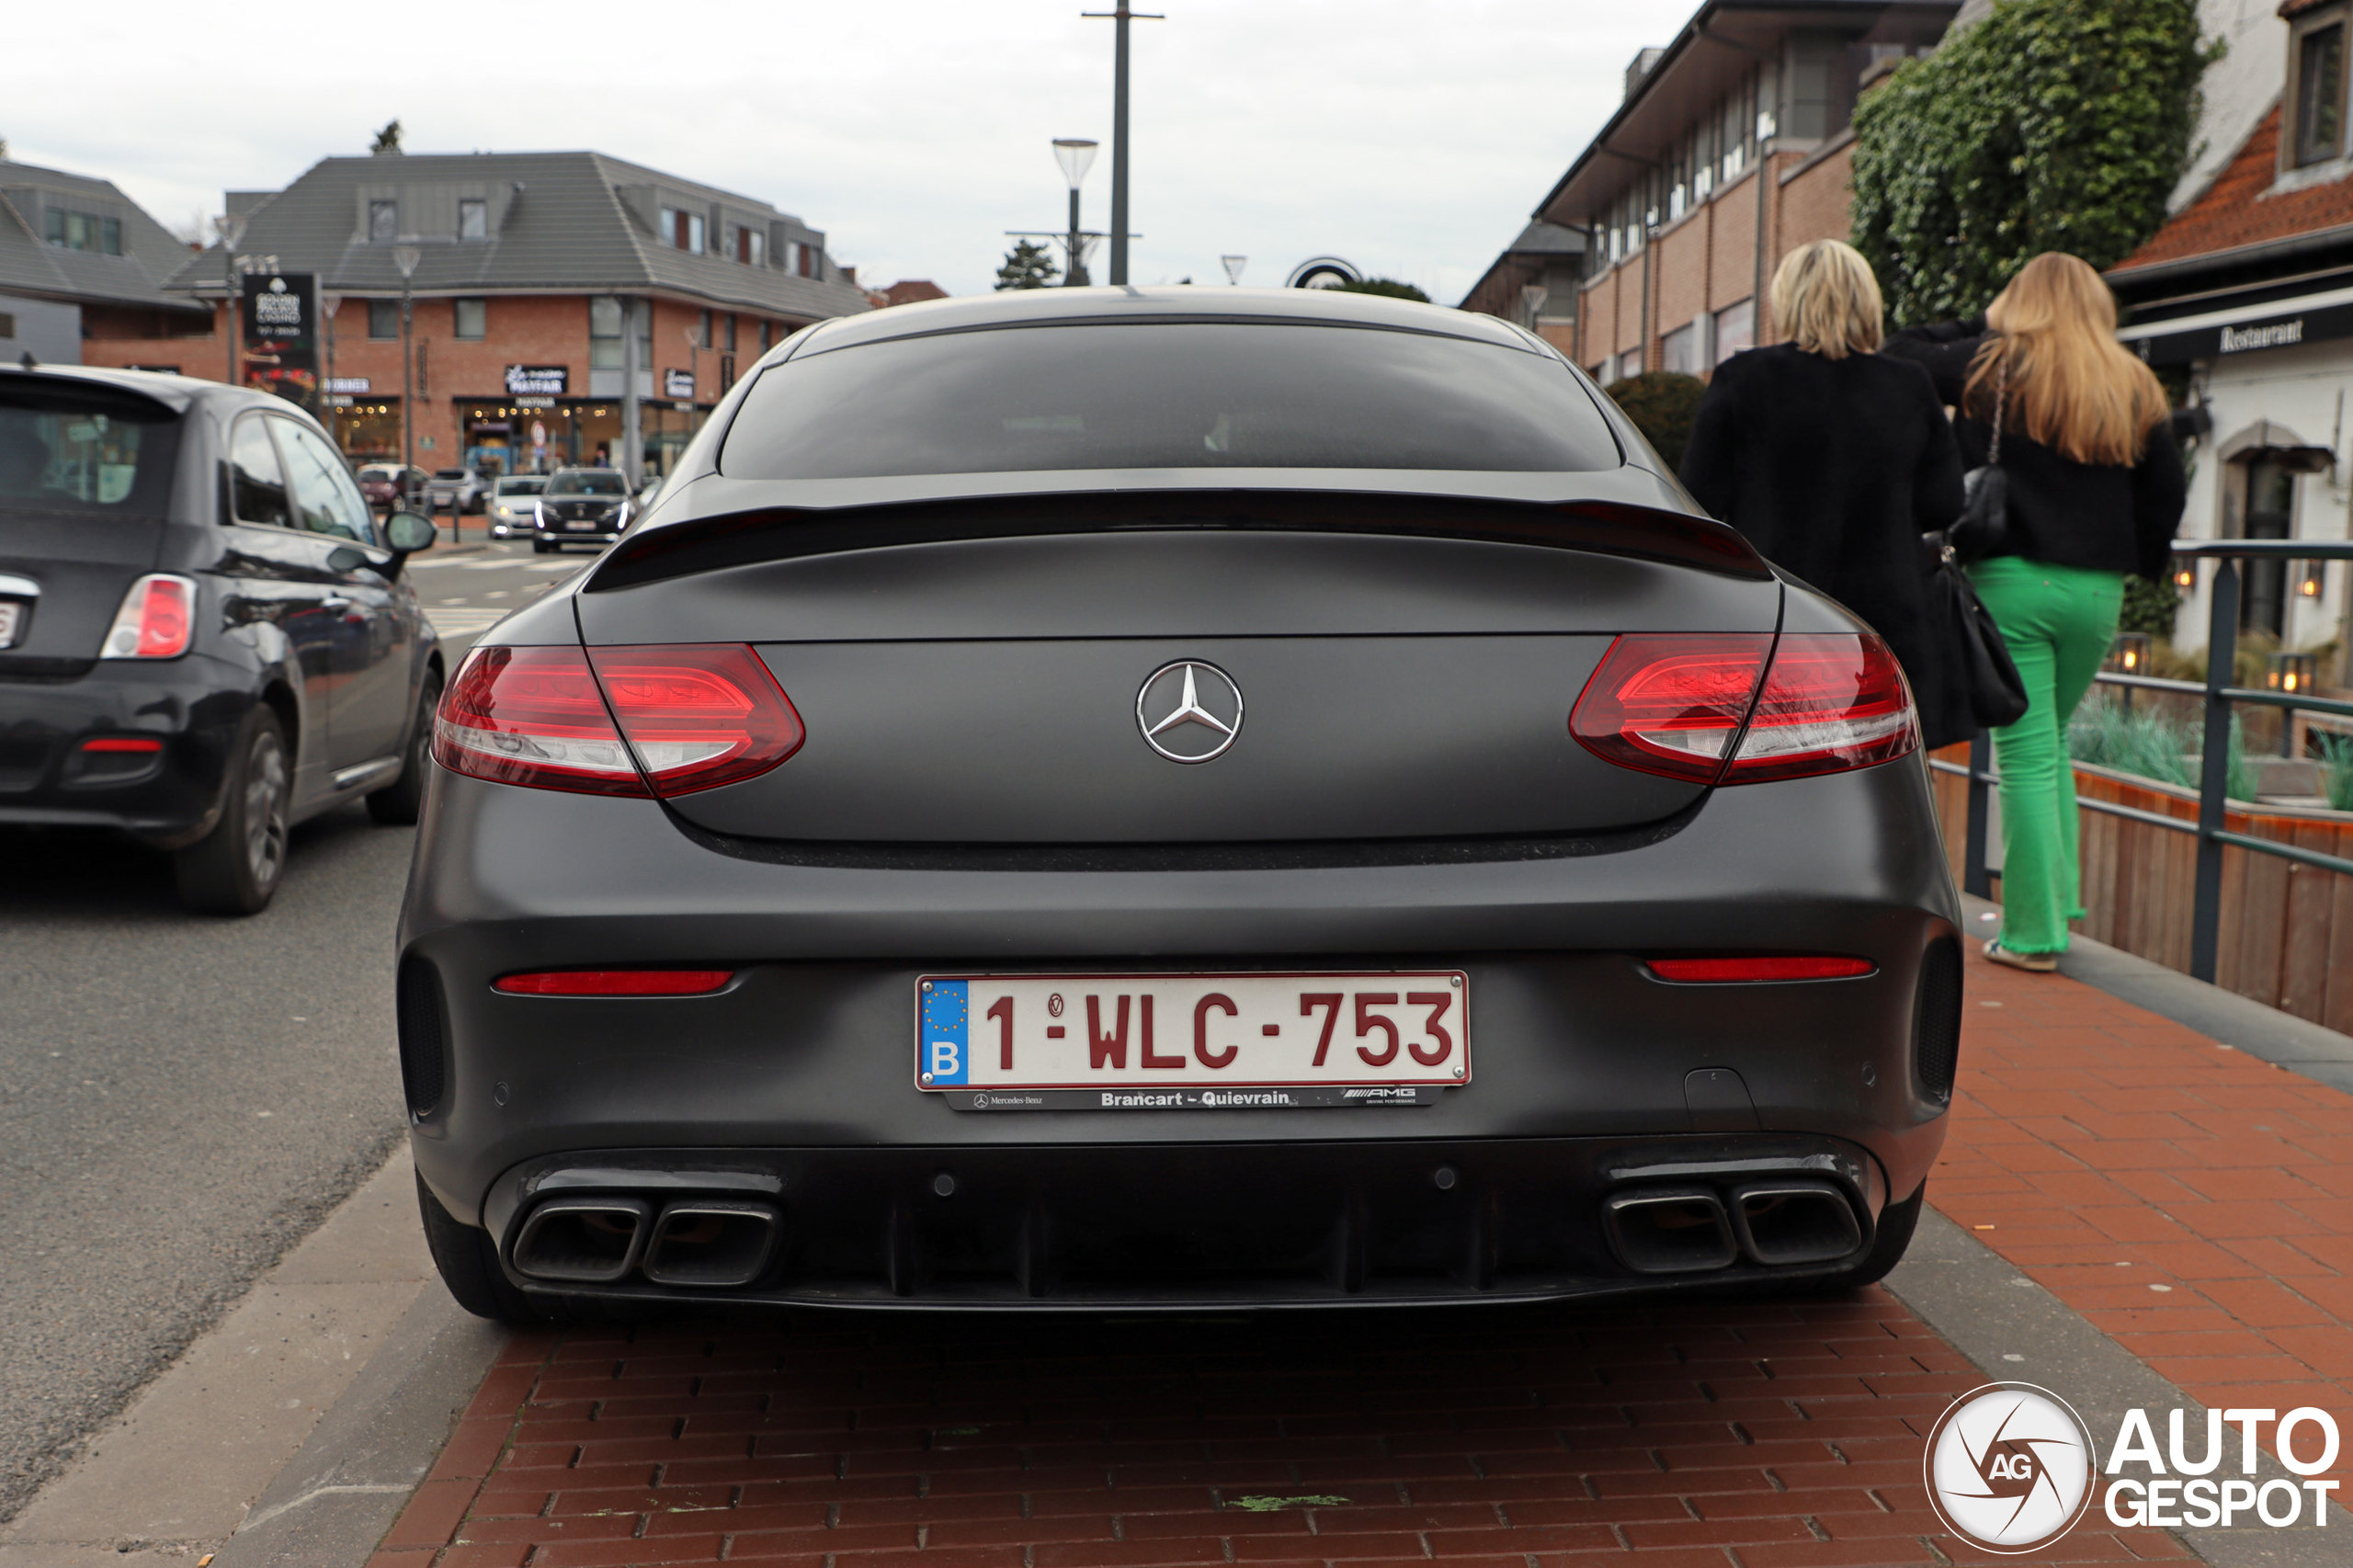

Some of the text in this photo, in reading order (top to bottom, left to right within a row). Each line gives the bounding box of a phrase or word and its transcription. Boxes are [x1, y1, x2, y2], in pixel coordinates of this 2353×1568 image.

[256, 312, 301, 324] CASINO
[2220, 319, 2302, 353] Restaurant
[509, 379, 563, 393] MAYFAIR
[516, 396, 555, 408] MAYFAIR
[931, 1041, 960, 1075] B
[991, 1096, 1042, 1105] Mercedes-Benz
[1101, 1092, 1182, 1106] Brancart
[1202, 1091, 1290, 1108] Quievrain
